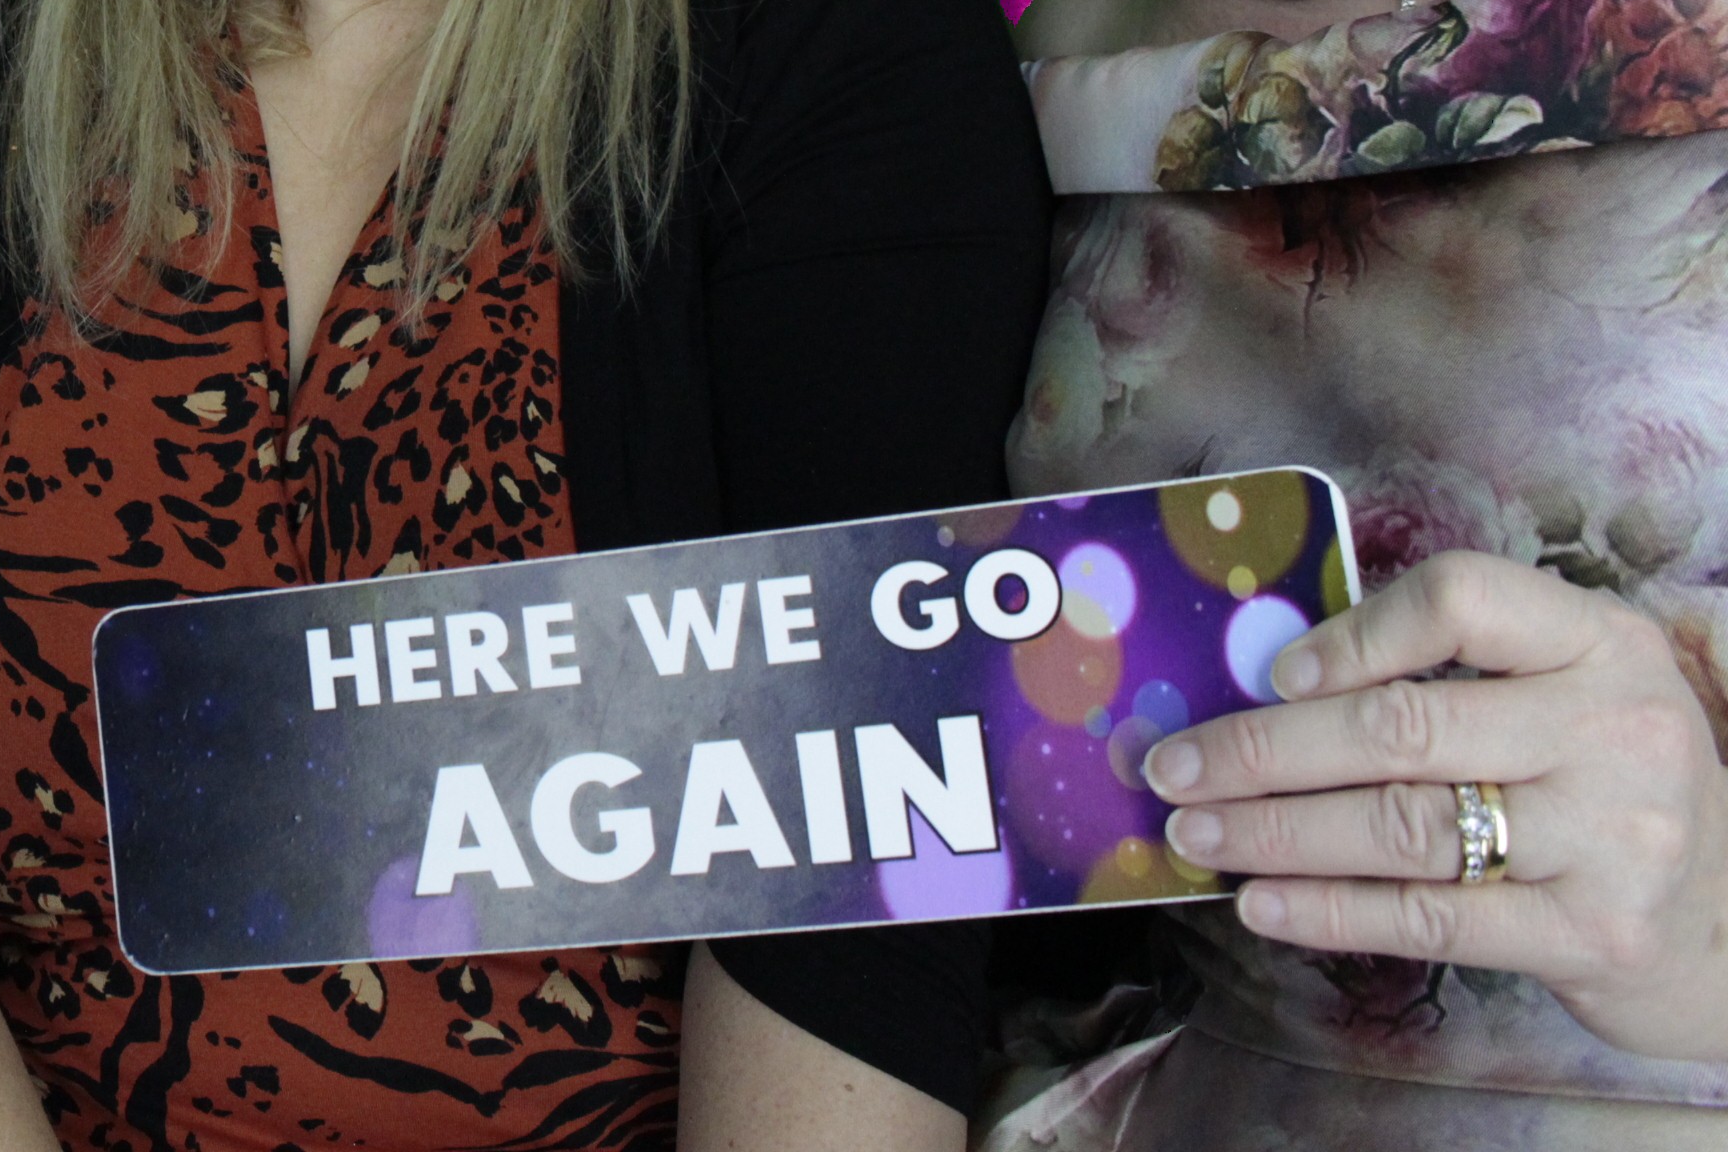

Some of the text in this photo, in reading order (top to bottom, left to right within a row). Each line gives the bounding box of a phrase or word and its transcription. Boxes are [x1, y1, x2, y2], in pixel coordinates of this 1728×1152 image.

[306, 548, 1060, 711] HERE WE GO
[414, 715, 998, 897] AGAIN
